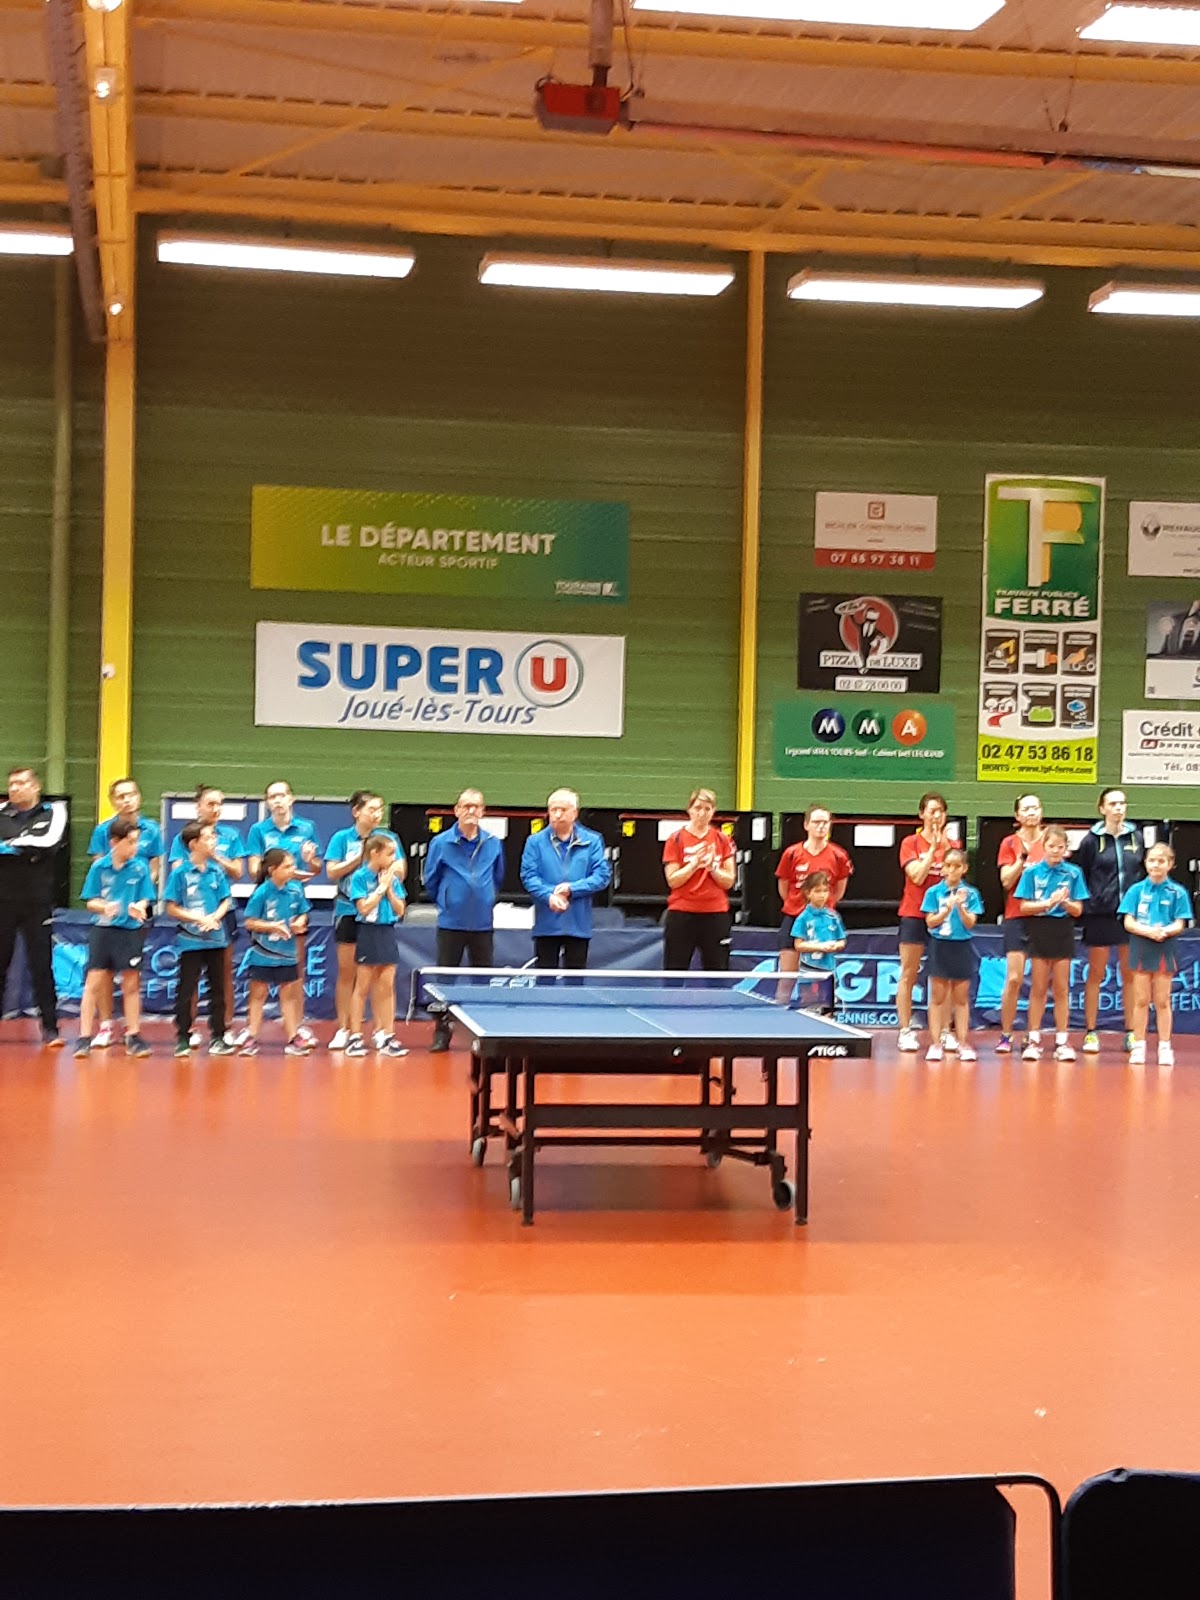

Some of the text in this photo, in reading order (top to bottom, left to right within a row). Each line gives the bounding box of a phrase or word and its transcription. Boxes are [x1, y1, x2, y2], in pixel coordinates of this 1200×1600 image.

[321, 521, 557, 555] LE DÉPARTEMENT
[378, 552, 498, 570] ACTEUR SPORTIF
[830, 552, 847, 563] 07
[994, 596, 1090, 617] FERRÉ
[297, 640, 567, 696] SUPER U
[823, 654, 858, 666] PIZZA
[883, 656, 918, 668] LUXE
[338, 694, 537, 724] Joué-lès-Tours
[1140, 720, 1193, 737] Crédit
[982, 744, 1093, 761] 02 47 53 86 18
[807, 1045, 848, 1057] STIGA
